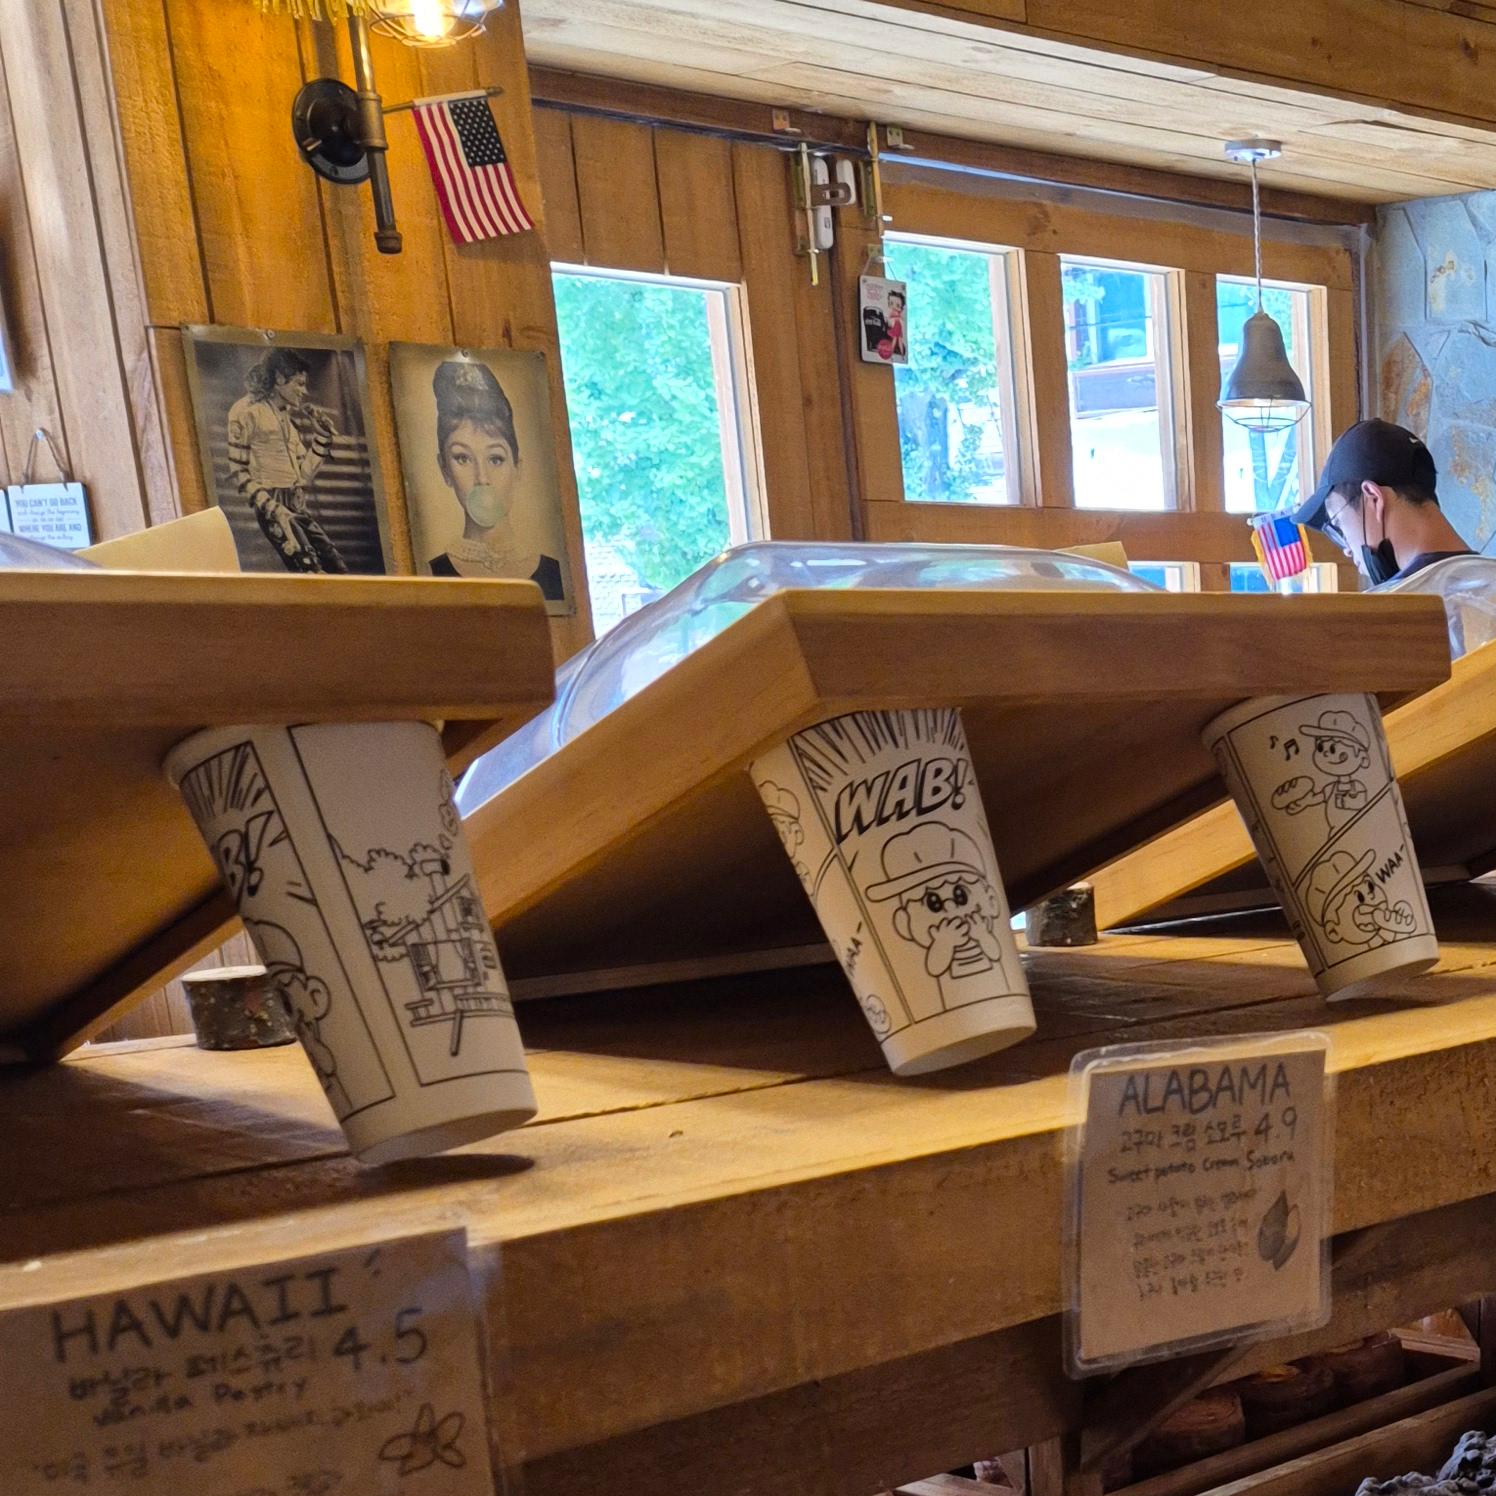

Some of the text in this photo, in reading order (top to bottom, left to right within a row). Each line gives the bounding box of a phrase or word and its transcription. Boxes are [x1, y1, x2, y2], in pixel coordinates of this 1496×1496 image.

[834, 757, 969, 846] WAB!
[1118, 1060, 1291, 1118] ALABAMA
[51, 1266, 350, 1363] HAWAII
[332, 1306, 428, 1371] 4.5
